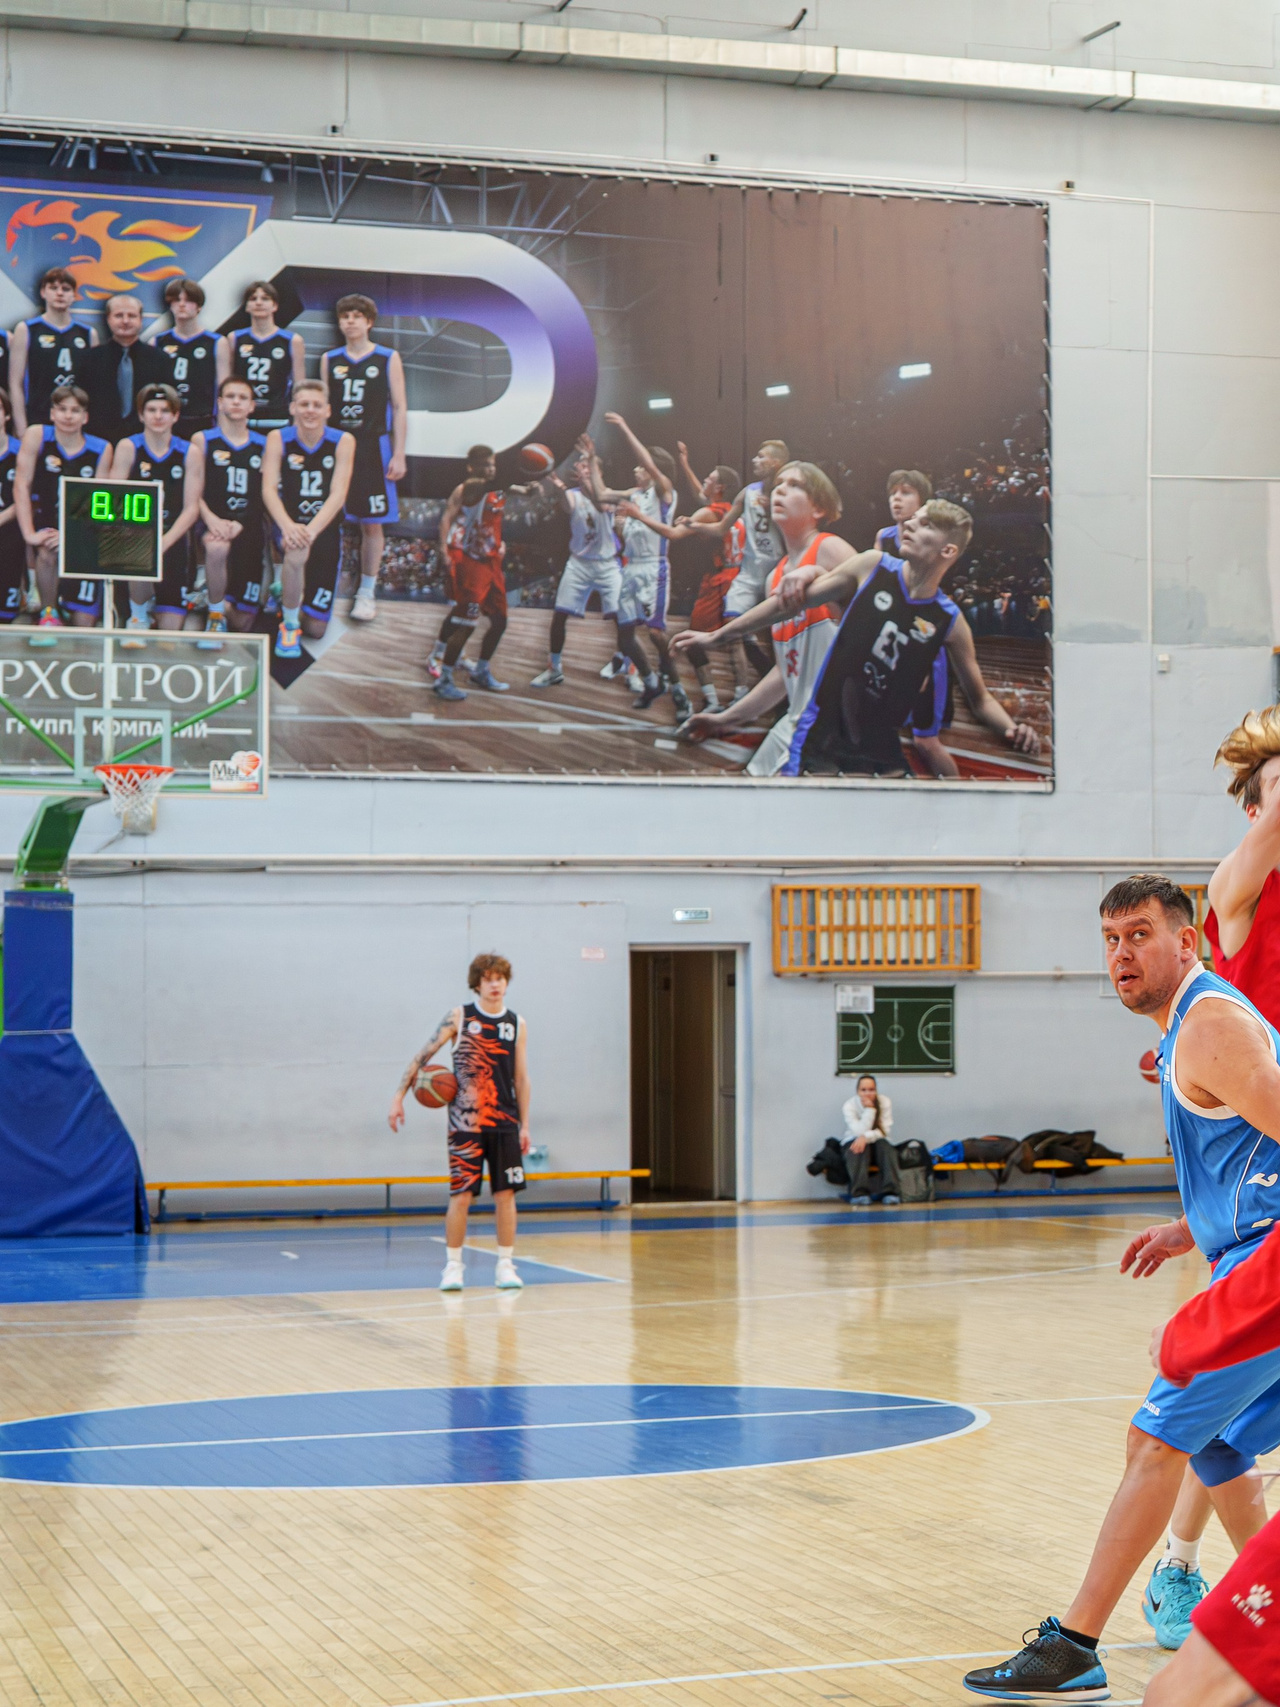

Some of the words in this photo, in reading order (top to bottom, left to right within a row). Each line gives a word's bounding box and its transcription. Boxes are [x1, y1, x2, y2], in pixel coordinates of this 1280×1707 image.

[57, 347, 73, 372] 4
[174, 357, 189, 381] 8
[247, 356, 272, 382] 22
[342, 378, 367, 402] 15
[226, 466, 248, 495] 19
[300, 470, 323, 497] 12
[91, 491, 150, 522] 8.10
[369, 494, 386, 514] 15
[77, 580, 95, 602] 11
[243, 581, 261, 603] 19
[312, 587, 333, 609] 12
[496, 1021, 515, 1042] 13
[504, 1165, 525, 1184] 13
